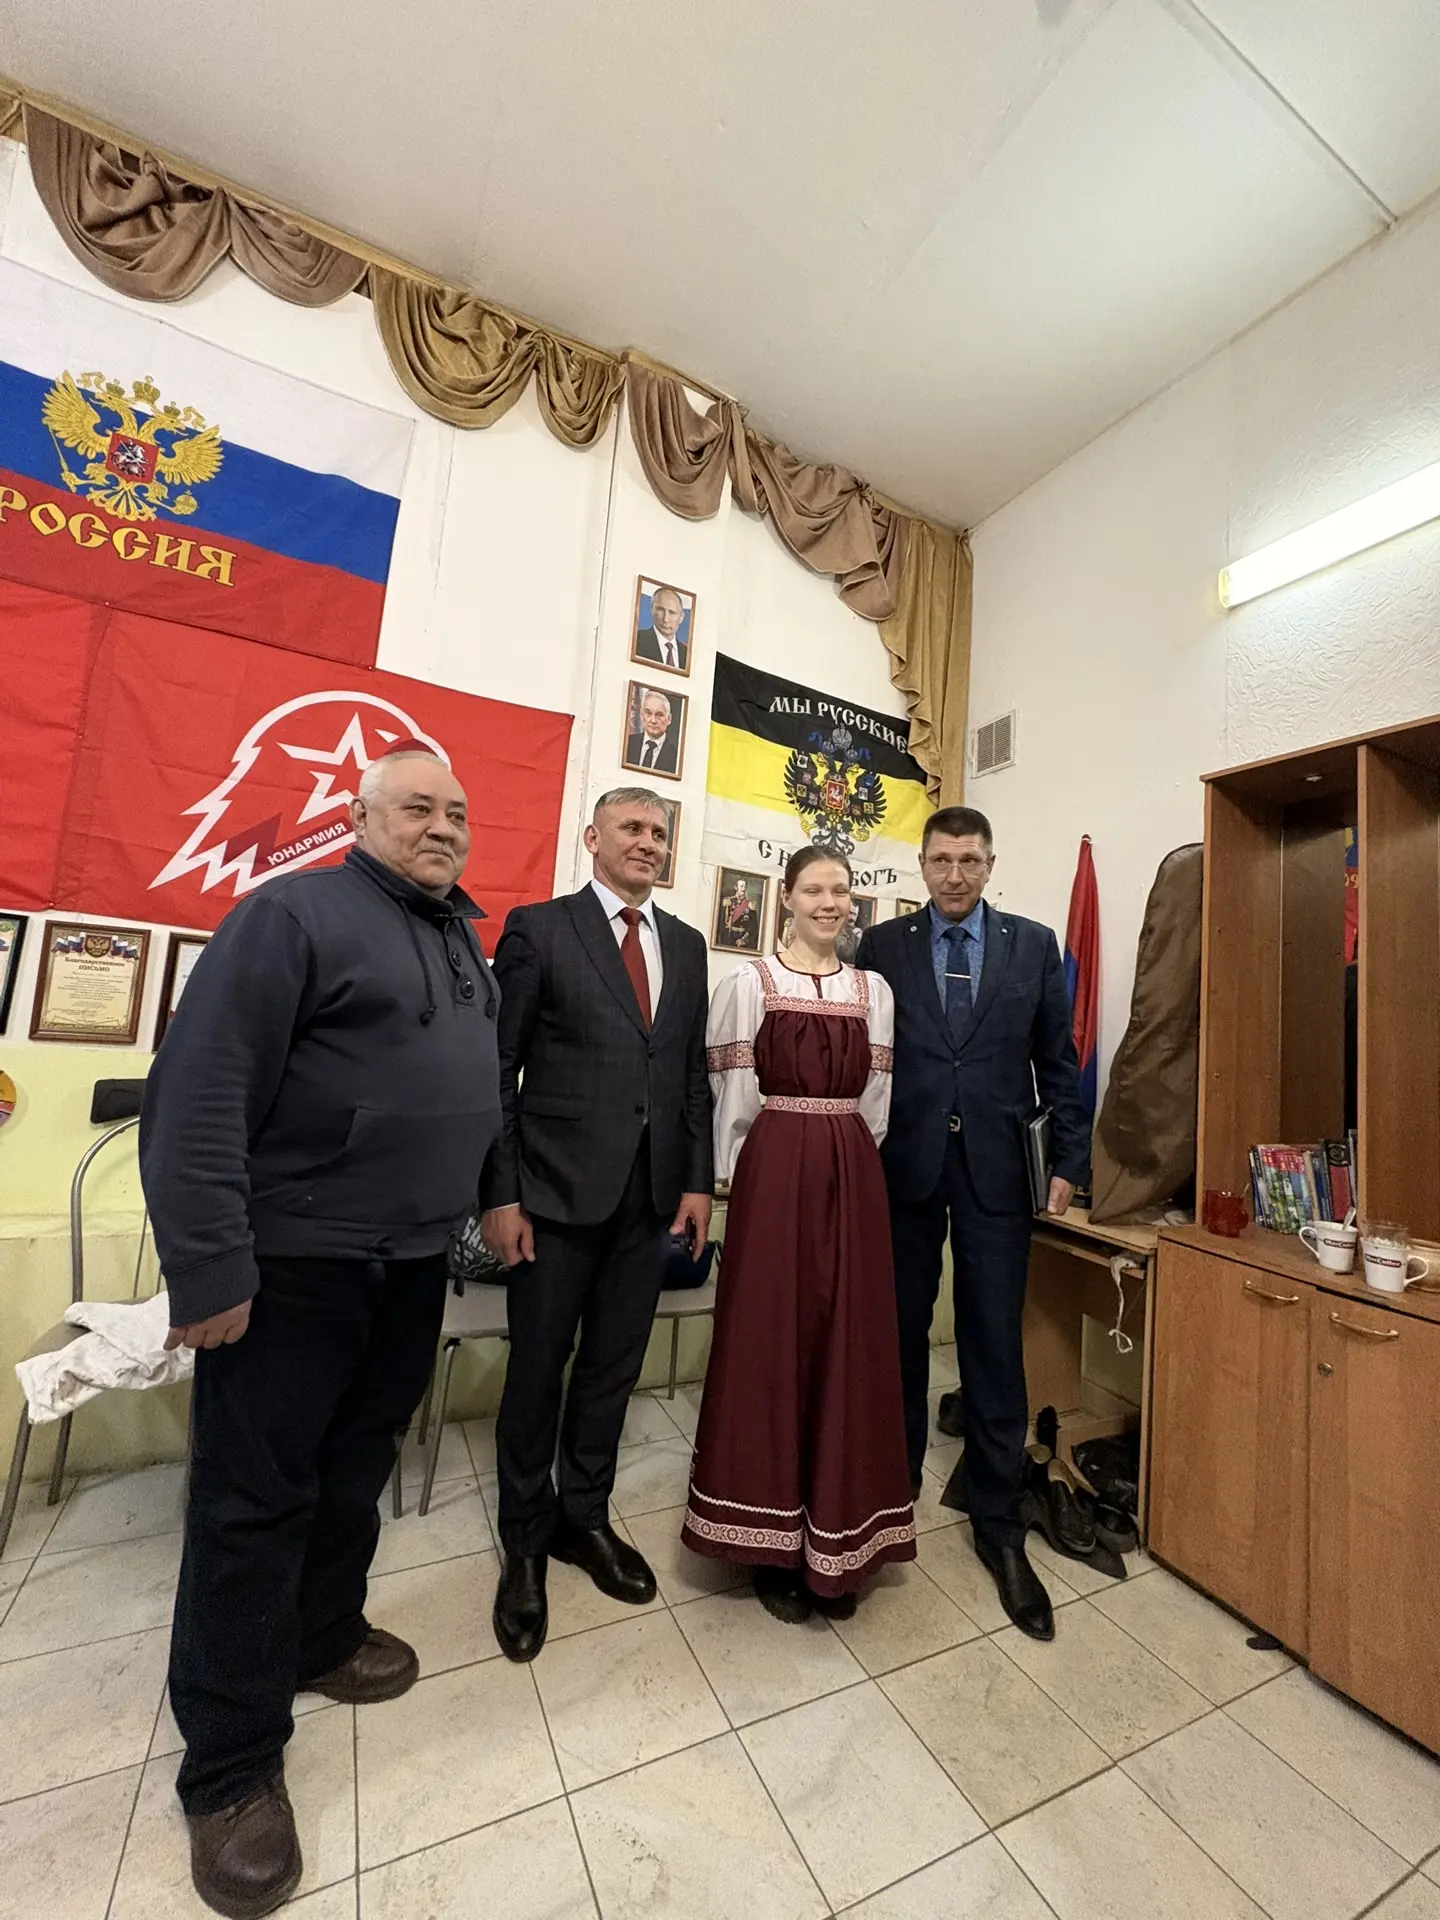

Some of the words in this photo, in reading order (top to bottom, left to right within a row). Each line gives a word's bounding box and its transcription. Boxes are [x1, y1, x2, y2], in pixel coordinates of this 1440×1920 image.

[0, 485, 238, 587] РОССИЯ
[769, 696, 812, 714] МЫ
[817, 701, 907, 753] РУССКИЕ
[267, 822, 347, 866] ЮНАРМИЯ
[758, 839, 773, 859] С
